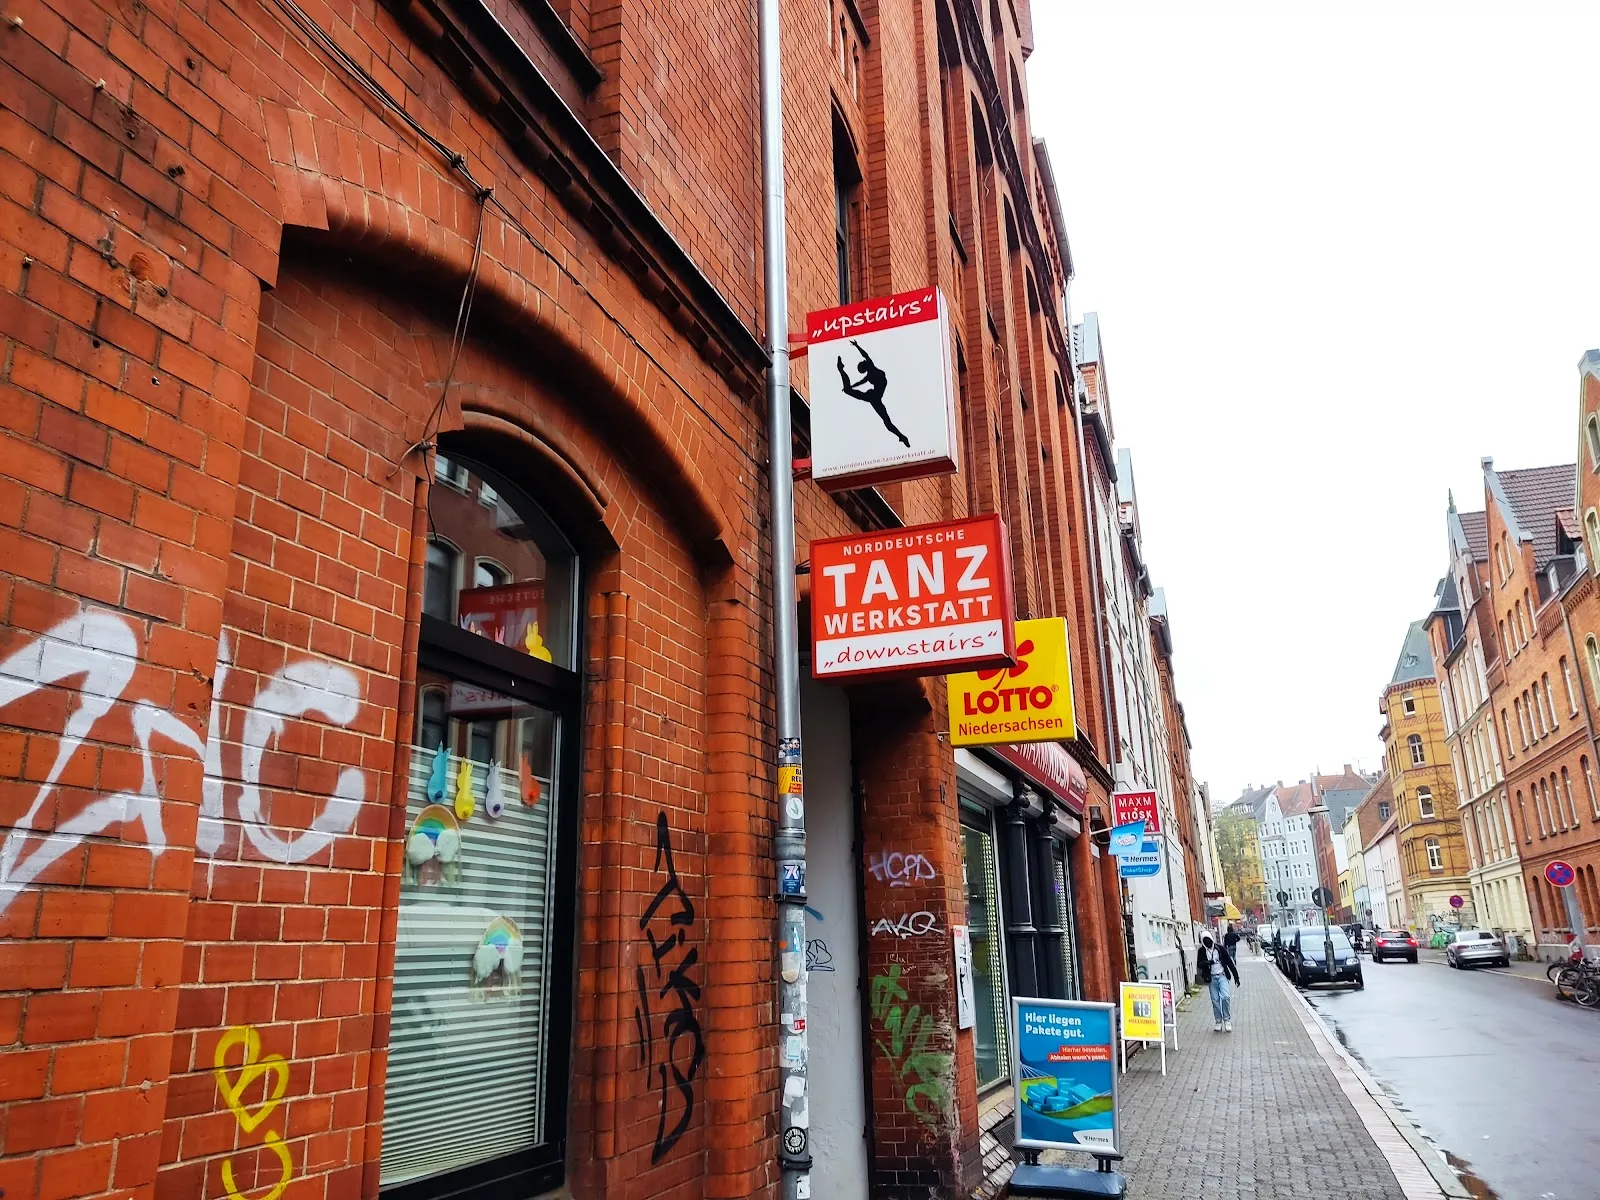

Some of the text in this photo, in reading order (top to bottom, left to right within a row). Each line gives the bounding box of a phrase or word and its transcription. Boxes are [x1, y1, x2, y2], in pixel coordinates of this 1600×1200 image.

[843, 529, 965, 556] NORDDEUTSCHE
[823, 544, 991, 608] TANZ
[824, 595, 993, 635] WERKSTATT
[958, 717, 1063, 736] Niedersachsen
[1118, 796, 1152, 808] MAXM
[1120, 810, 1153, 821] KIOSK
[1130, 855, 1158, 863] Hermes
[1025, 1012, 1081, 1027] Hier liegen
[1025, 1024, 1085, 1039] Pakete gut.
[1089, 1135, 1109, 1143] Hermes
